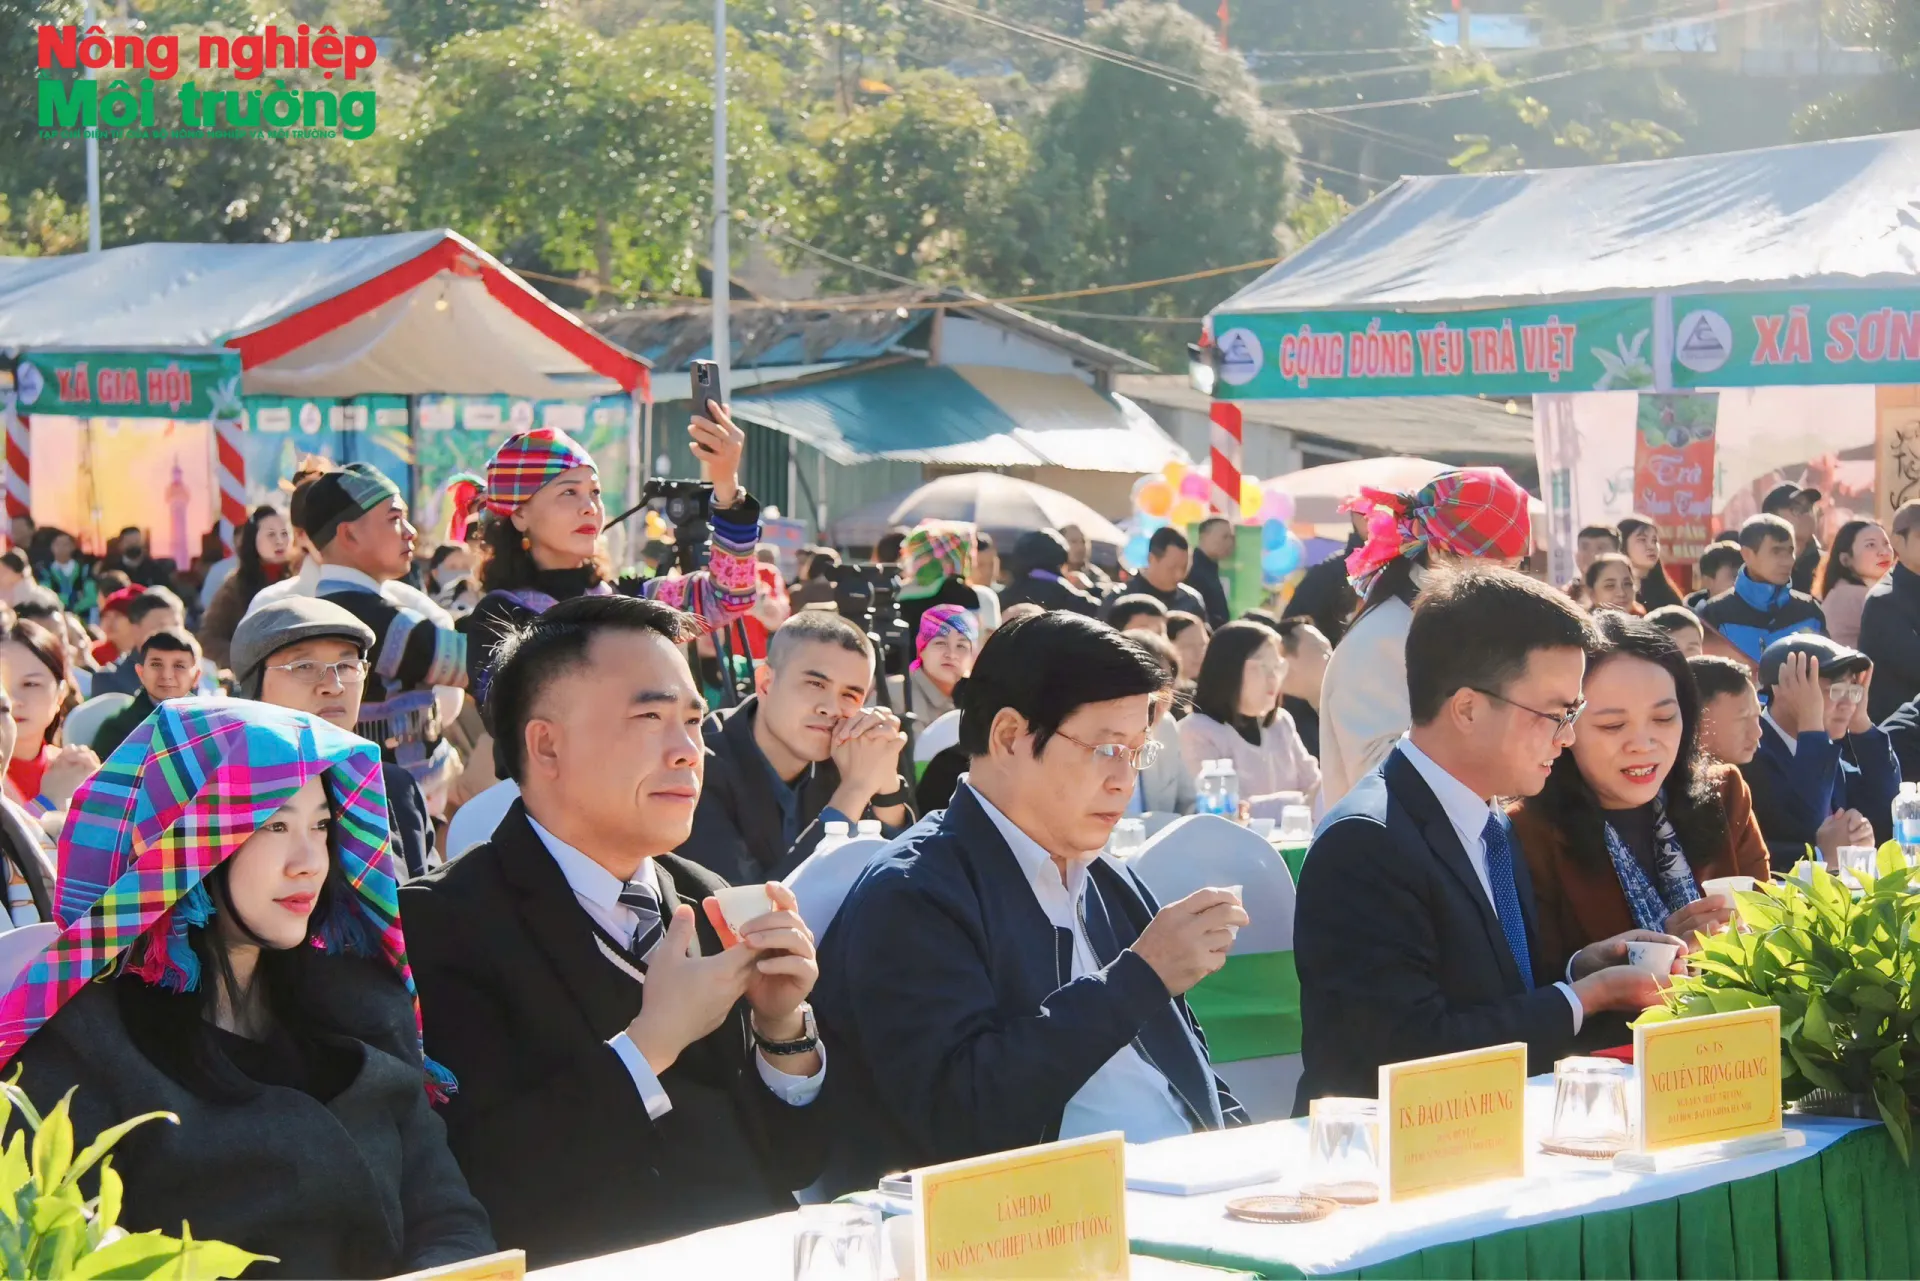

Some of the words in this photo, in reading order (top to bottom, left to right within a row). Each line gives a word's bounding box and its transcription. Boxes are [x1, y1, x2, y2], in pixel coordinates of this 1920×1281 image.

[1280, 325, 1344, 388] CỘNG
[1349, 318, 1413, 377] ĐỒNG
[1417, 321, 1463, 375] YÊU
[1468, 318, 1517, 374] TRÀ
[1521, 315, 1576, 382] VIỆT
[1752, 305, 1811, 364] XÃ
[55, 362, 90, 403] XÃ
[97, 367, 141, 405] GIA
[146, 364, 192, 412] HỘI
[1697, 1062, 1732, 1089] TRỌNG
[1734, 1056, 1767, 1079] GIANG
[1446, 1090, 1477, 1121] XUÂN
[952, 1241, 984, 1267] NÔNG
[986, 1234, 1026, 1261] NGHIỆP
[1045, 1219, 1068, 1247] MÔI
